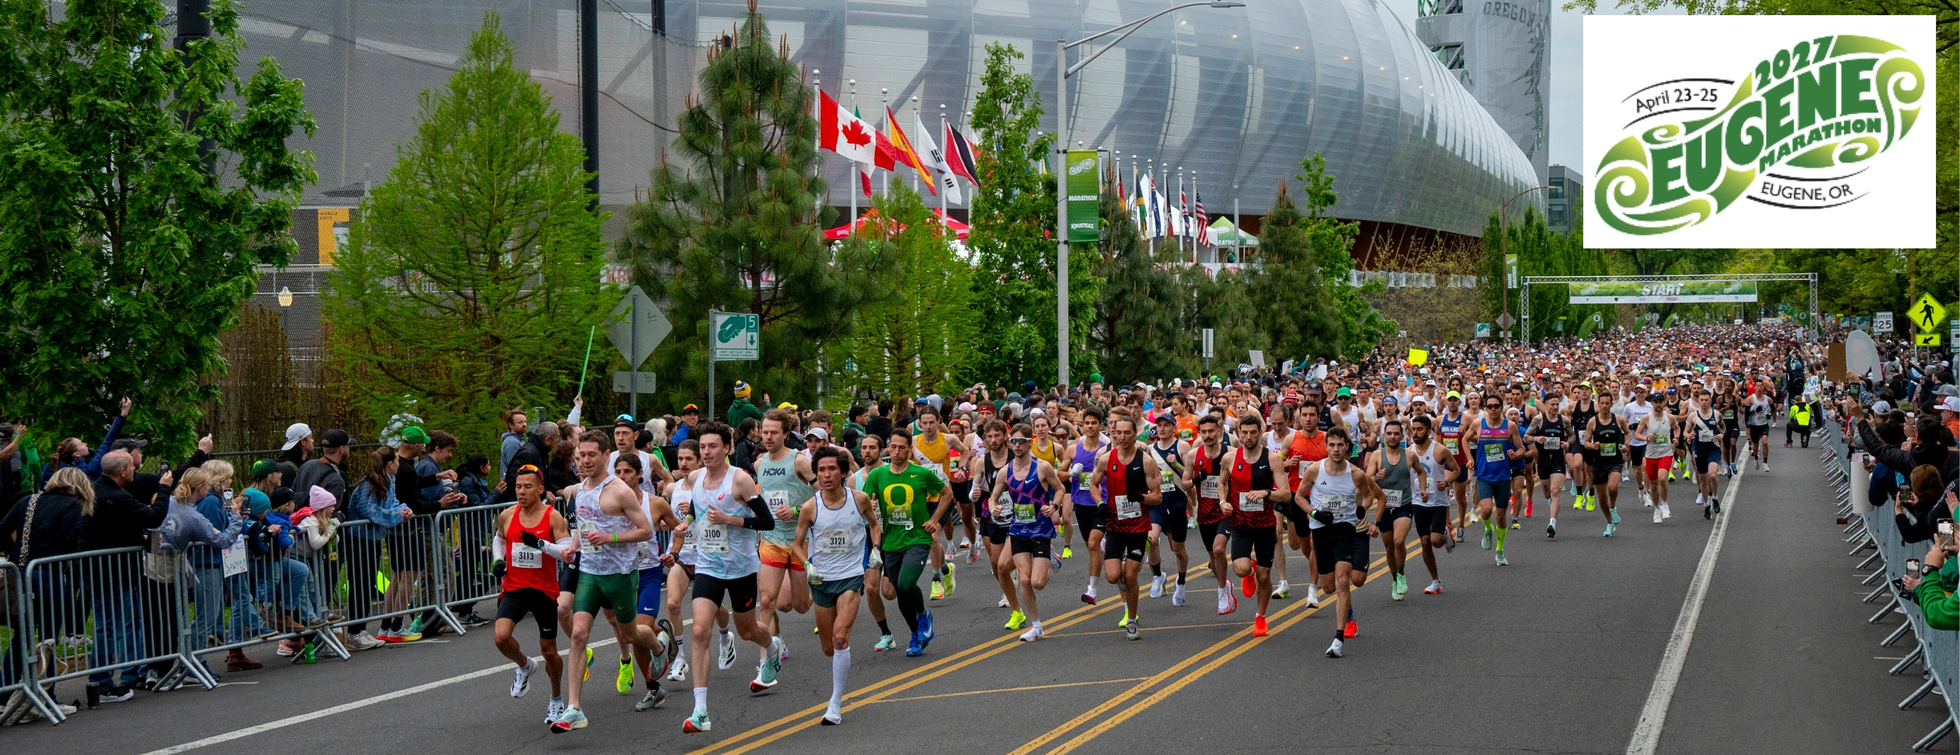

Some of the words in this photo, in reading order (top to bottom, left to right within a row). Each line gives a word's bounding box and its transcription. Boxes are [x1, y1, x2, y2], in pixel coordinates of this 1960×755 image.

[1641, 284, 1682, 296] START
[748, 316, 756, 328] 5
[1878, 321, 1892, 329] 25
[763, 468, 785, 476] HOKA
[883, 483, 914, 507] O
[705, 529, 720, 538] 3100
[830, 537, 845, 546] 3121
[519, 551, 534, 560] 3113
